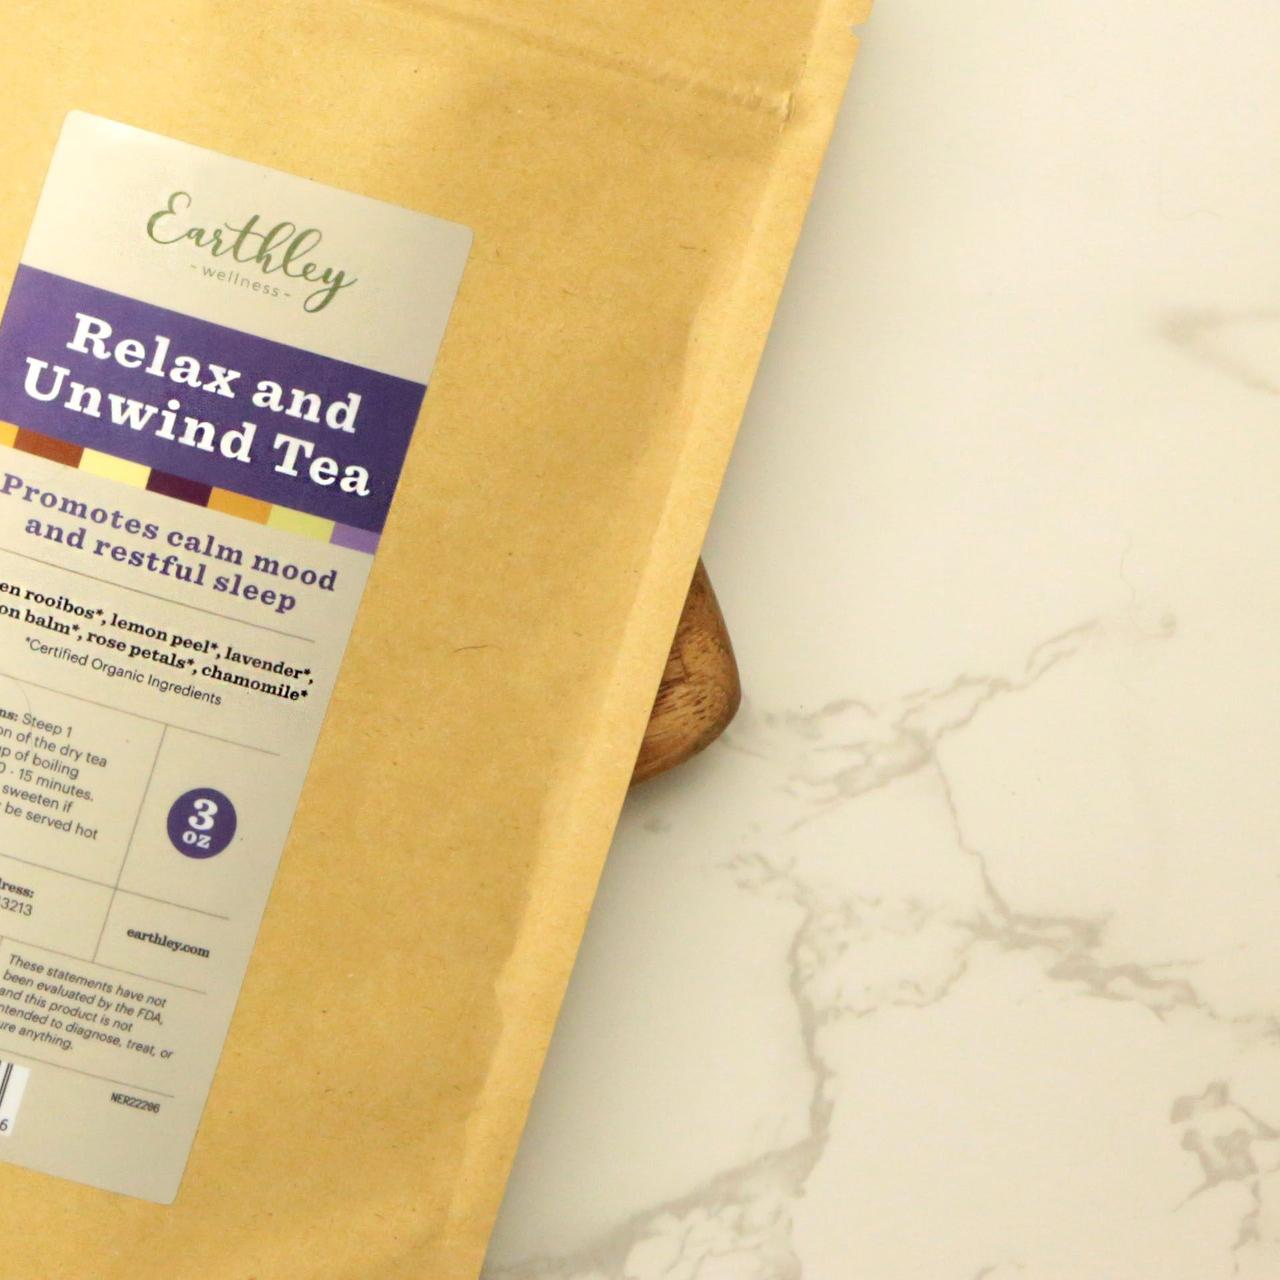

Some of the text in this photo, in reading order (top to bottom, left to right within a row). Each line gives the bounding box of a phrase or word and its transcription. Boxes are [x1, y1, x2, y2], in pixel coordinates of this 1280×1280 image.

[145, 190, 359, 314] Earthley
[65, 311, 362, 434] Relax and
[23, 355, 370, 497] Unwind Tea
[24, 518, 296, 615] and restful sleep
[166, 530, 243, 566] calm
[250, 554, 338, 592] mood
[85, 631, 127, 652] rose
[109, 612, 168, 642] lemon
[90, 657, 145, 684] Organic
[146, 673, 222, 706] Ingredients
[21, 711, 63, 737] Steep
[65, 725, 73, 739] 1
[13, 749, 31, 763] of
[31, 752, 80, 781] boiling
[15, 730, 33, 744] of
[33, 735, 57, 753] the
[58, 743, 83, 762] dry
[84, 751, 108, 768] tea
[1, 783, 60, 811] sweeten
[61, 799, 74, 813] if
[18, 767, 34, 783] 15
[34, 775, 94, 802] minutes.
[3, 800, 23, 818] be
[24, 810, 73, 833] served
[73, 821, 99, 841] hot
[187, 797, 218, 831] 3
[125, 928, 210, 959] earthley.com
[1, 968, 163, 1026] been evaluated by the FDA,
[8, 953, 167, 1009] These statements have not
[23, 992, 47, 1009] this
[46, 1001, 99, 1023] product
[98, 1013, 111, 1027] is
[111, 1019, 134, 1033] not
[17, 1026, 73, 1051] anything.
[49, 1017, 64, 1030] to
[64, 1021, 122, 1048] diagnose,
[125, 1038, 156, 1057] treat,
[158, 1048, 174, 1060] or
